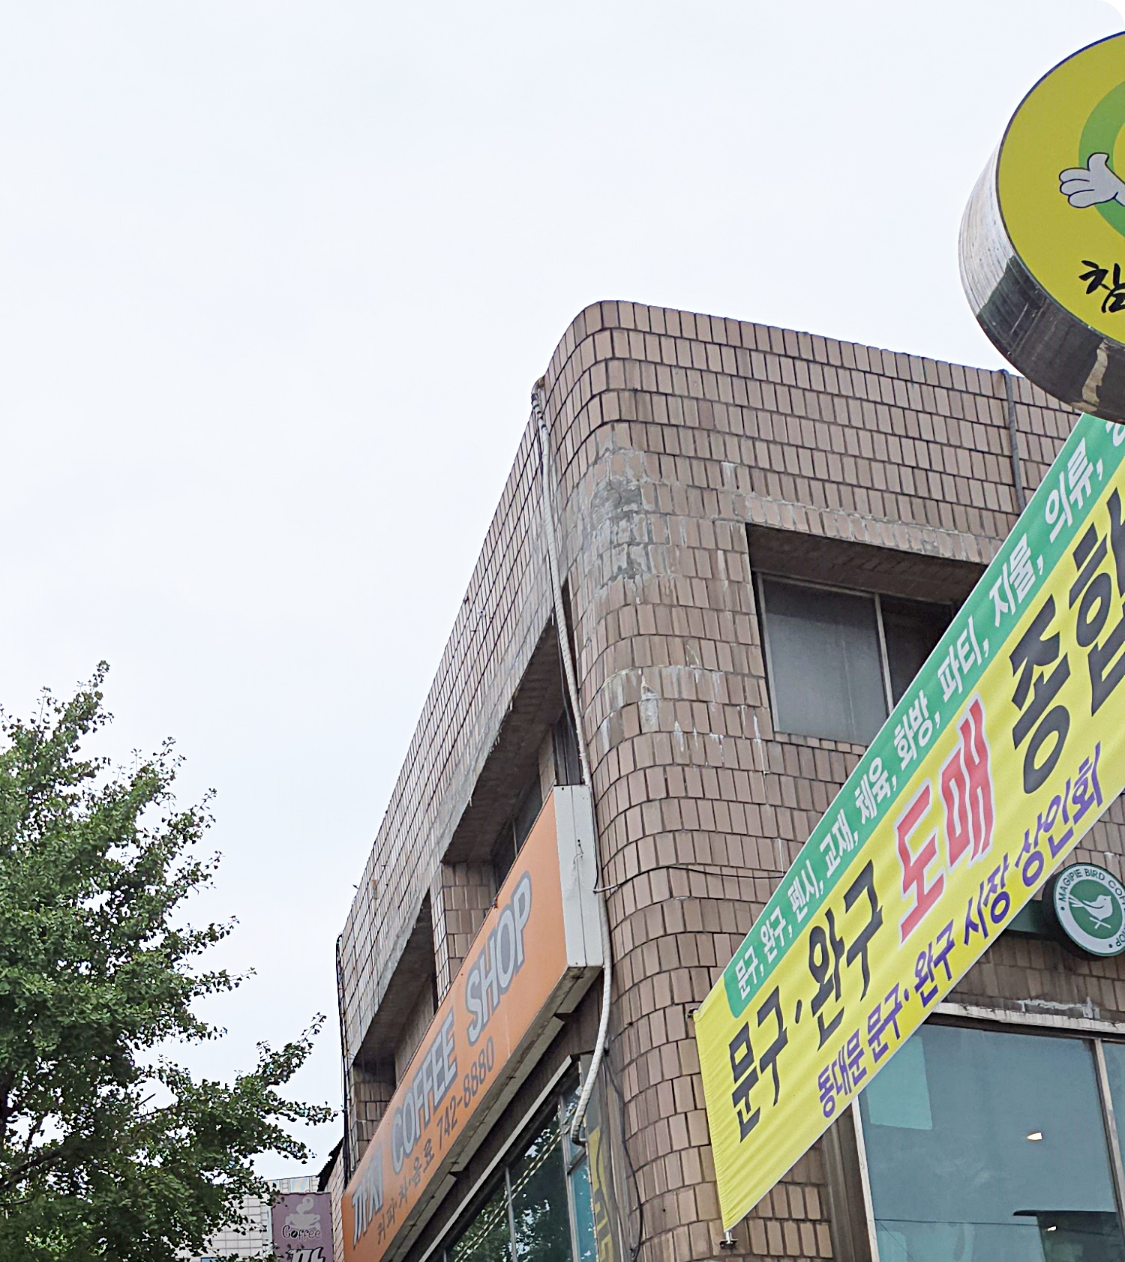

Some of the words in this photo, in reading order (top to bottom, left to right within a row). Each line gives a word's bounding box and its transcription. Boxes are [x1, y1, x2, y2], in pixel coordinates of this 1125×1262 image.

[818, 1028, 868, 1119] 동대문
[964, 852, 1011, 946] 시장
[1015, 741, 1104, 887] 상인회
[896, 698, 992, 943] 도매
[1084, 868, 1106, 881] BIRD
[391, 1004, 458, 1175] COFFEE
[465, 870, 532, 1047] SHOP
